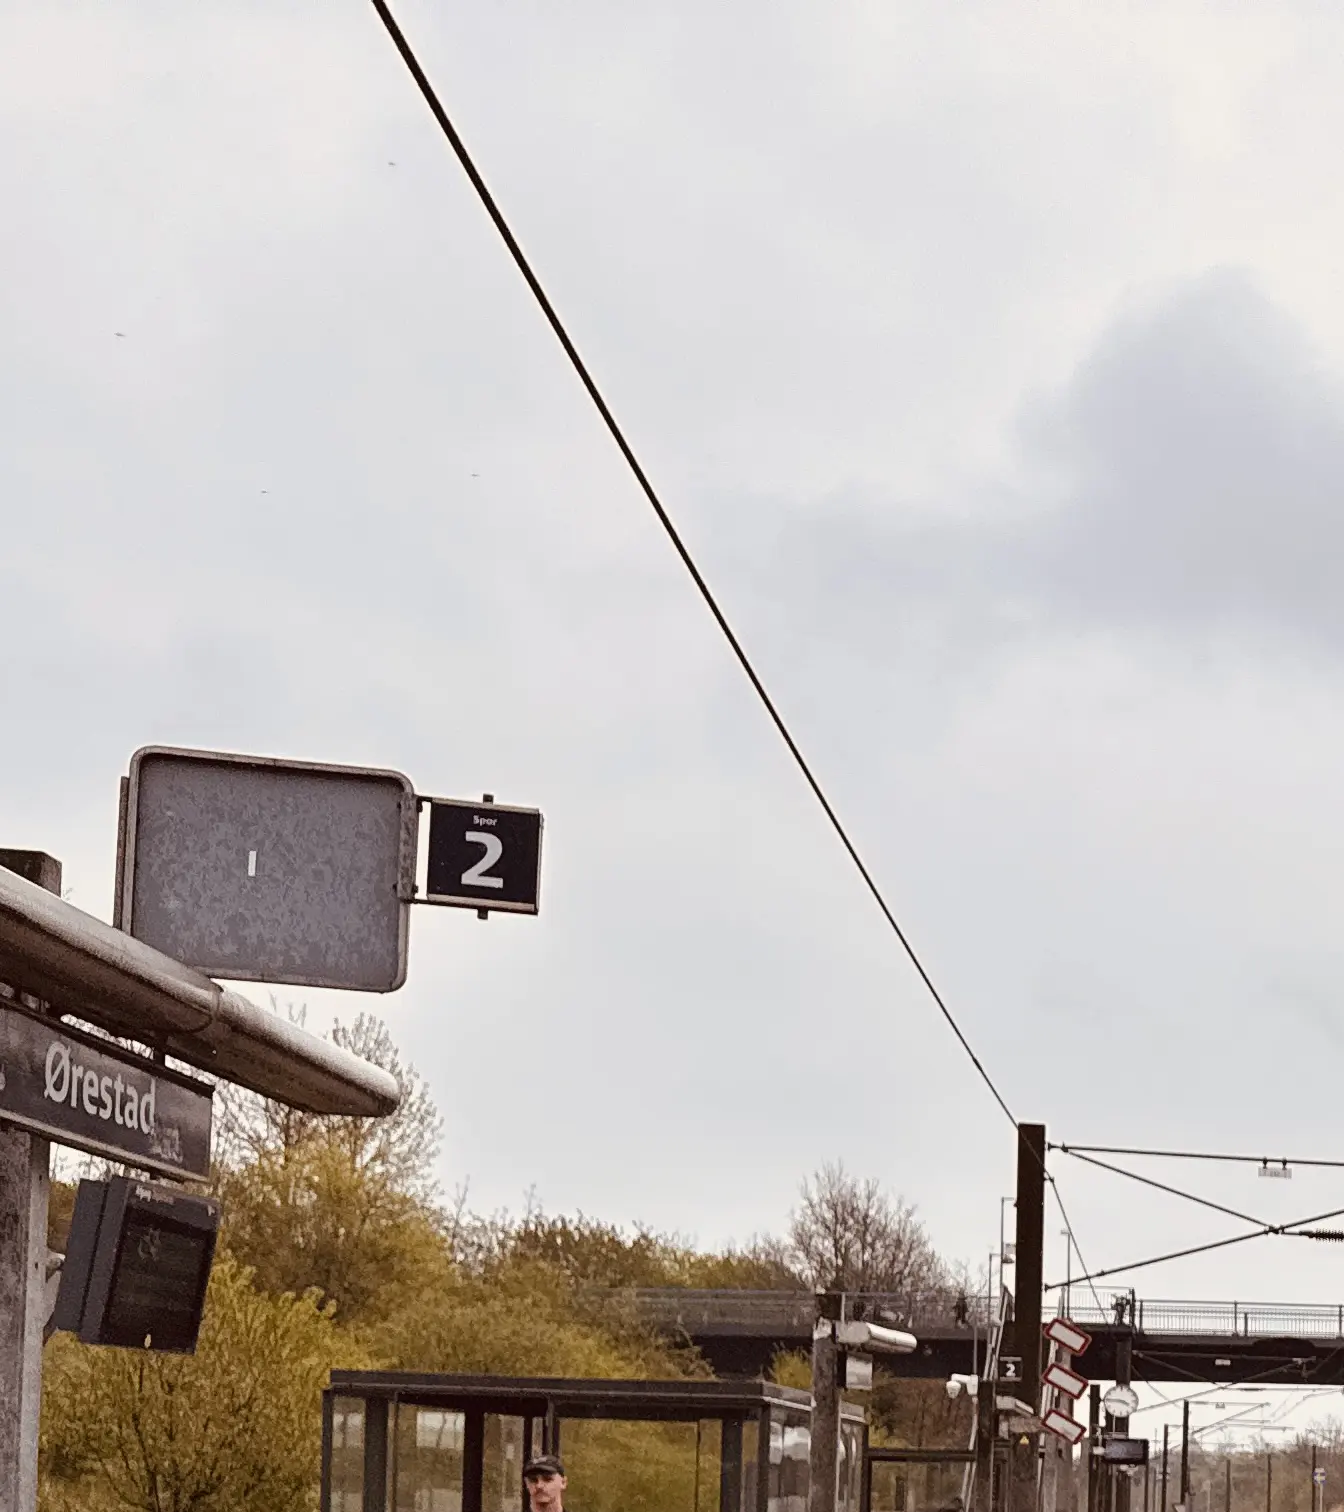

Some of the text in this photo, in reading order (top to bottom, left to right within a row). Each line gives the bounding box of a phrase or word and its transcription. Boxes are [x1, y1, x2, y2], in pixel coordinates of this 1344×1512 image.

[473, 814, 499, 827] Spor
[460, 830, 504, 889] 2
[44, 1041, 156, 1135] Ørestad
[1005, 1363, 1016, 1377] 2
